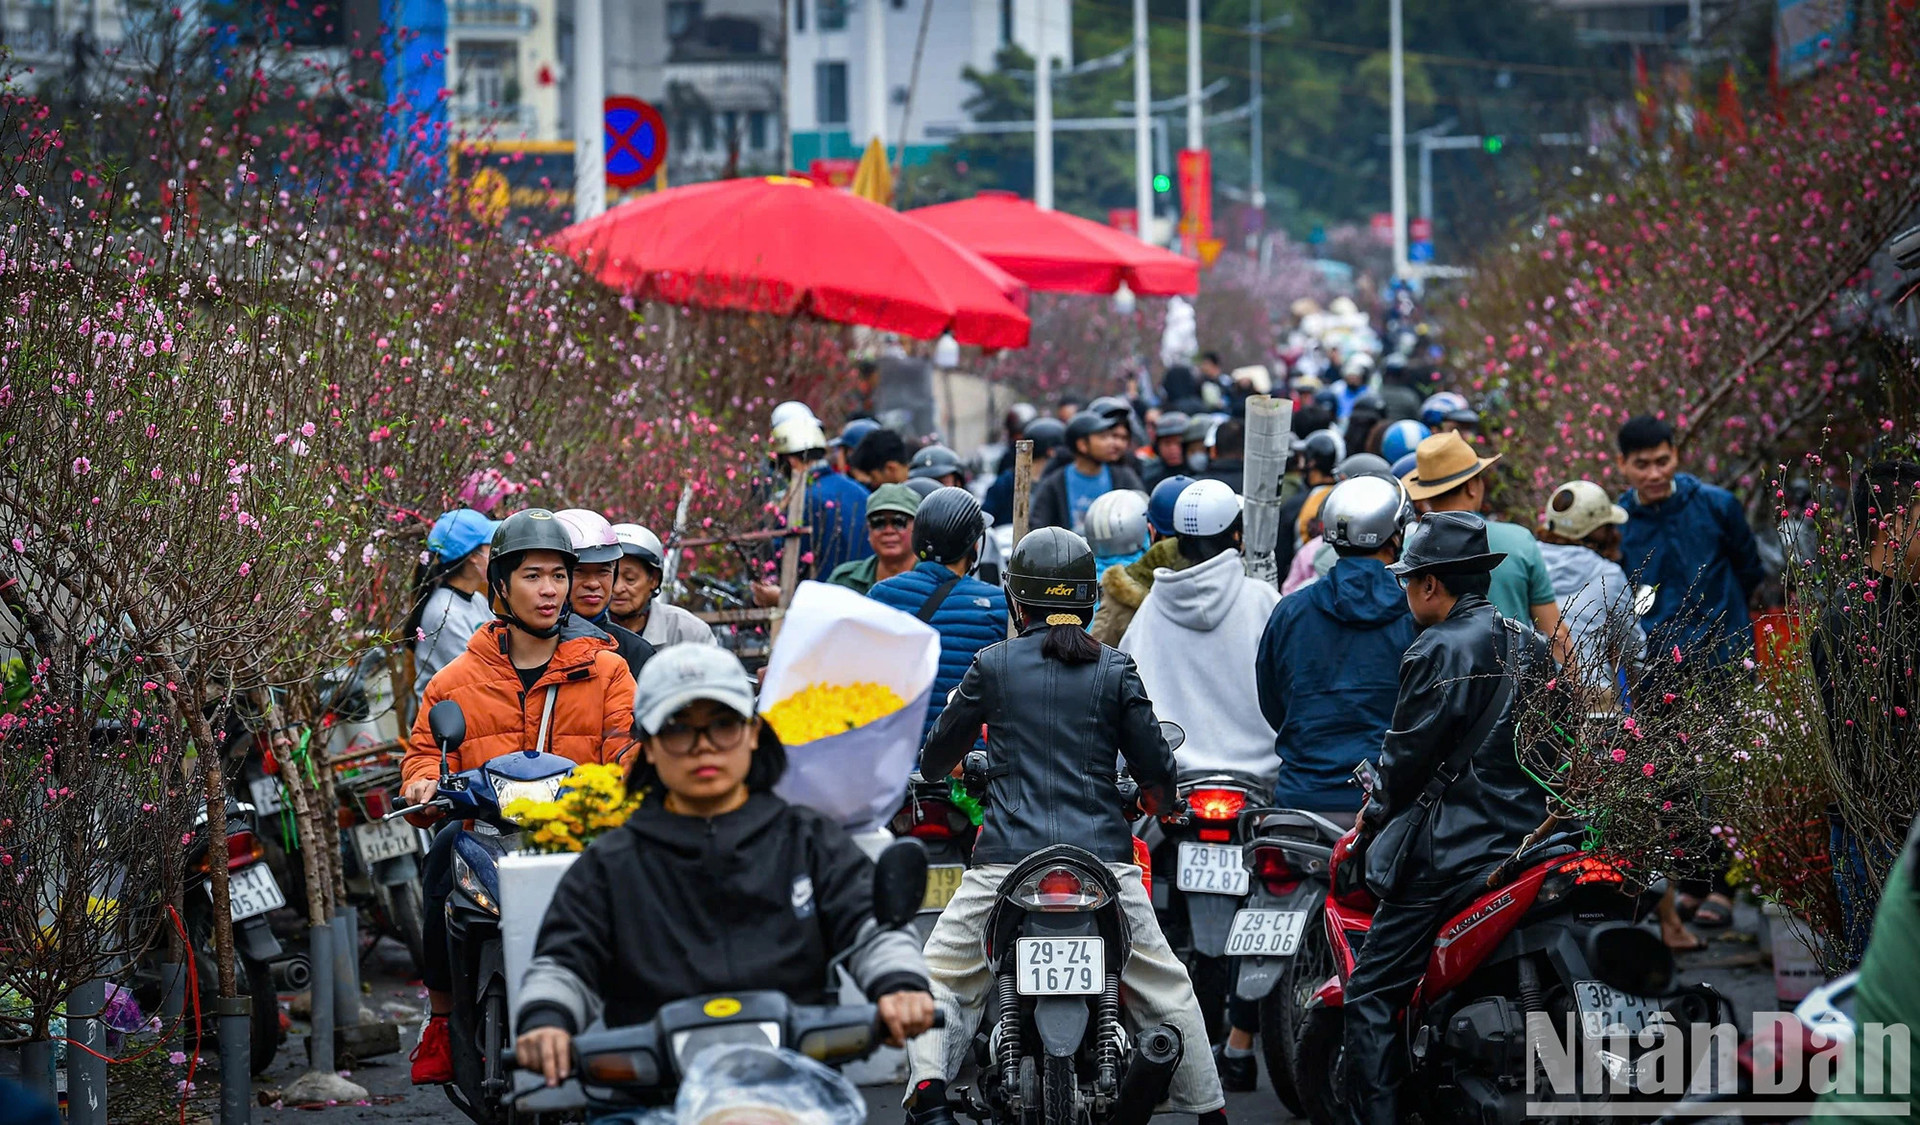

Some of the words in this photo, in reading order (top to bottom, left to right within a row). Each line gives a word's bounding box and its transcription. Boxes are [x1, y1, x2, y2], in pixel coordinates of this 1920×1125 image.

[1190, 847, 1238, 869] 29-D1
[1183, 868, 1243, 891] 872.87
[231, 887, 278, 916] 05.11
[1242, 913, 1295, 932] 29-C1
[1029, 941, 1092, 965] 29-Z4
[1231, 933, 1294, 952] 009.06
[1031, 967, 1092, 991] 1679
